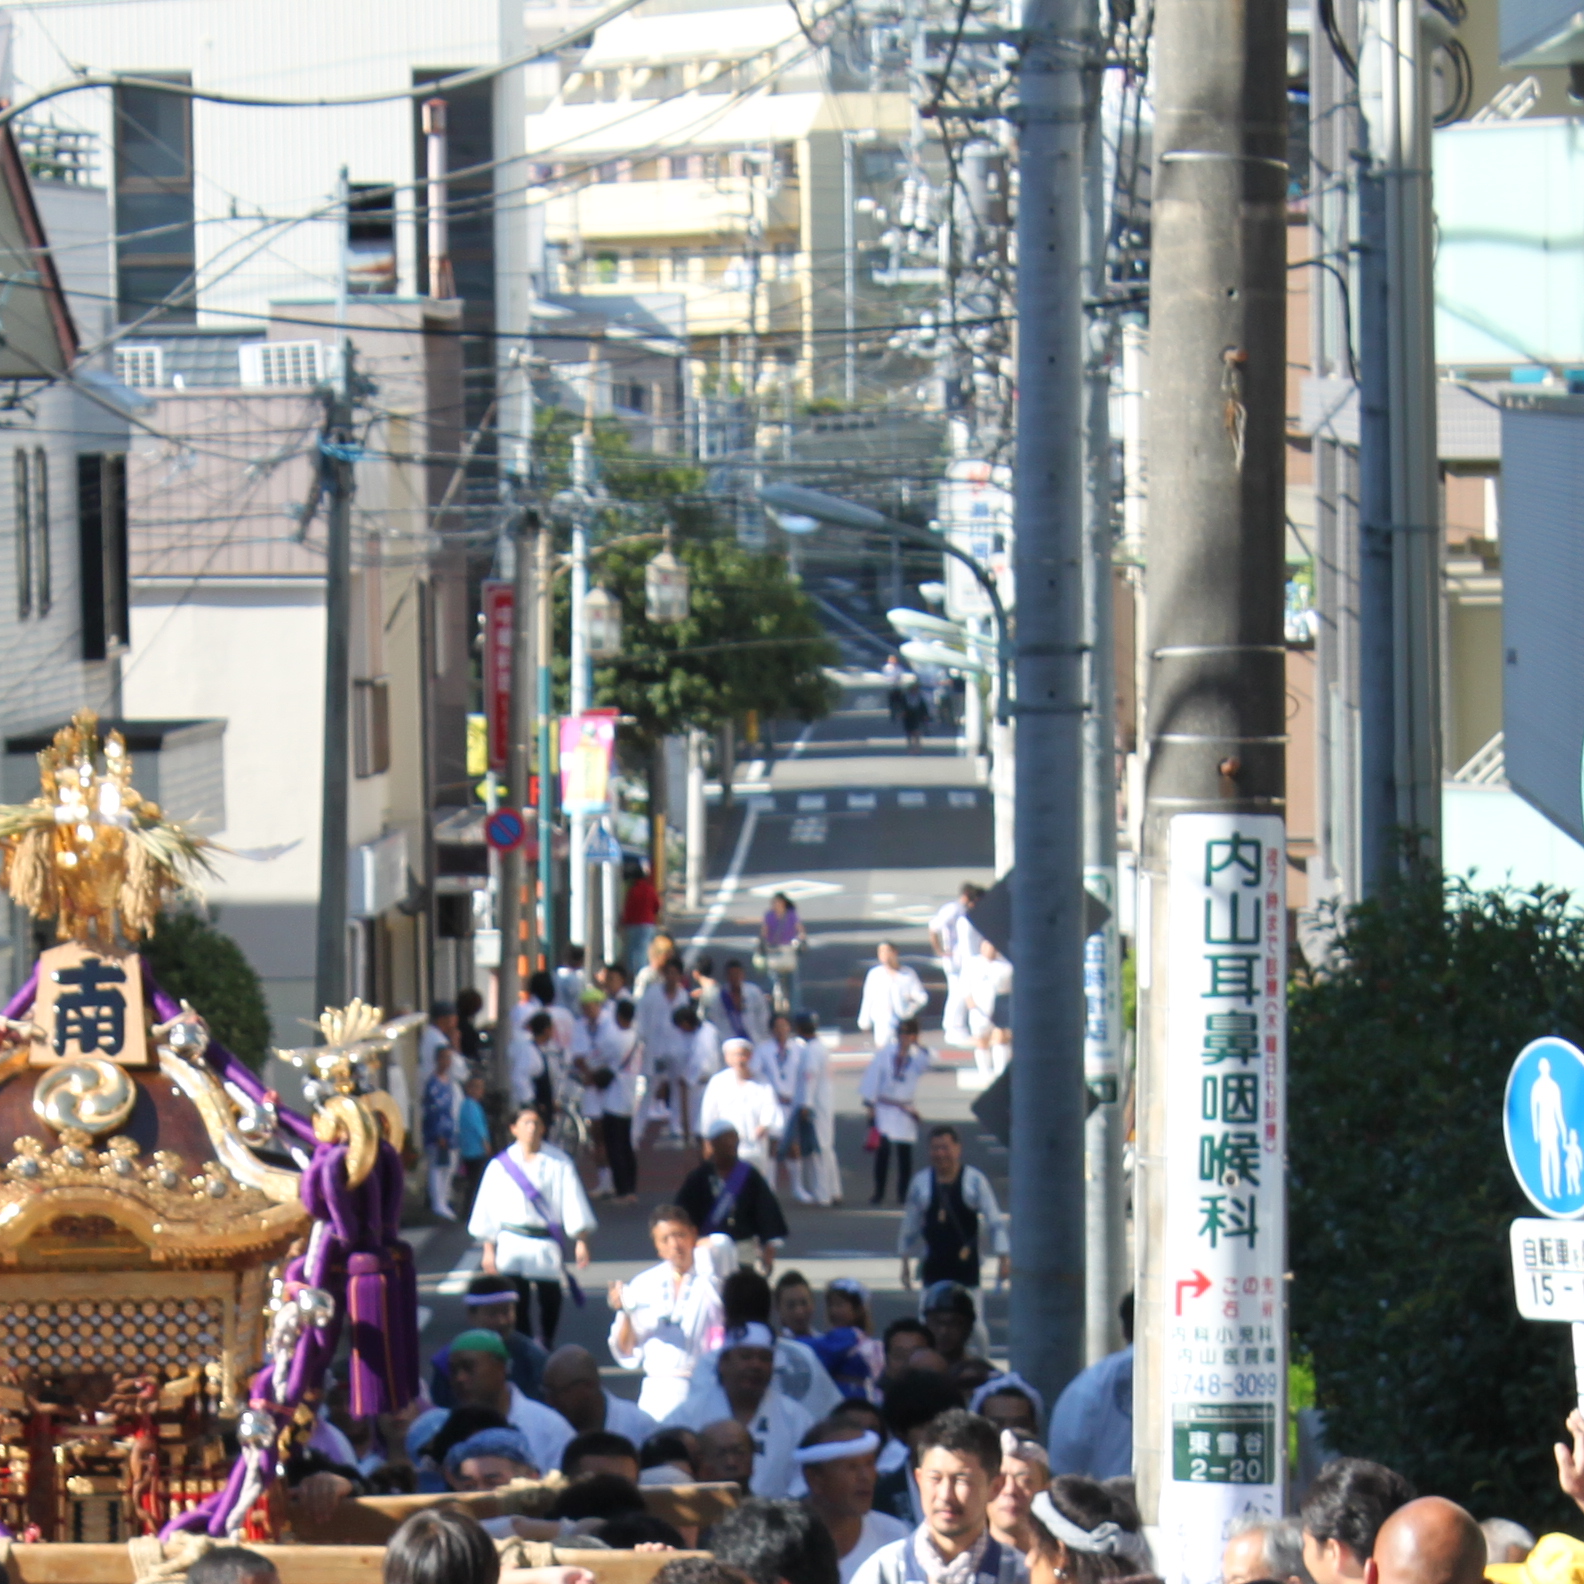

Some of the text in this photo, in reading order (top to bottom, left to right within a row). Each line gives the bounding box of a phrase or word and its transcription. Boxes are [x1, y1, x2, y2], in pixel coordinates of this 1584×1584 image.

[49, 957, 127, 1056] 南
[1198, 831, 1260, 1248] 内山耳鼻咽喉科
[1170, 1372, 1278, 1397] 3748-3099
[1188, 1431, 1264, 1457] 東雪谷
[1189, 1459, 1263, 1483] 2-20
